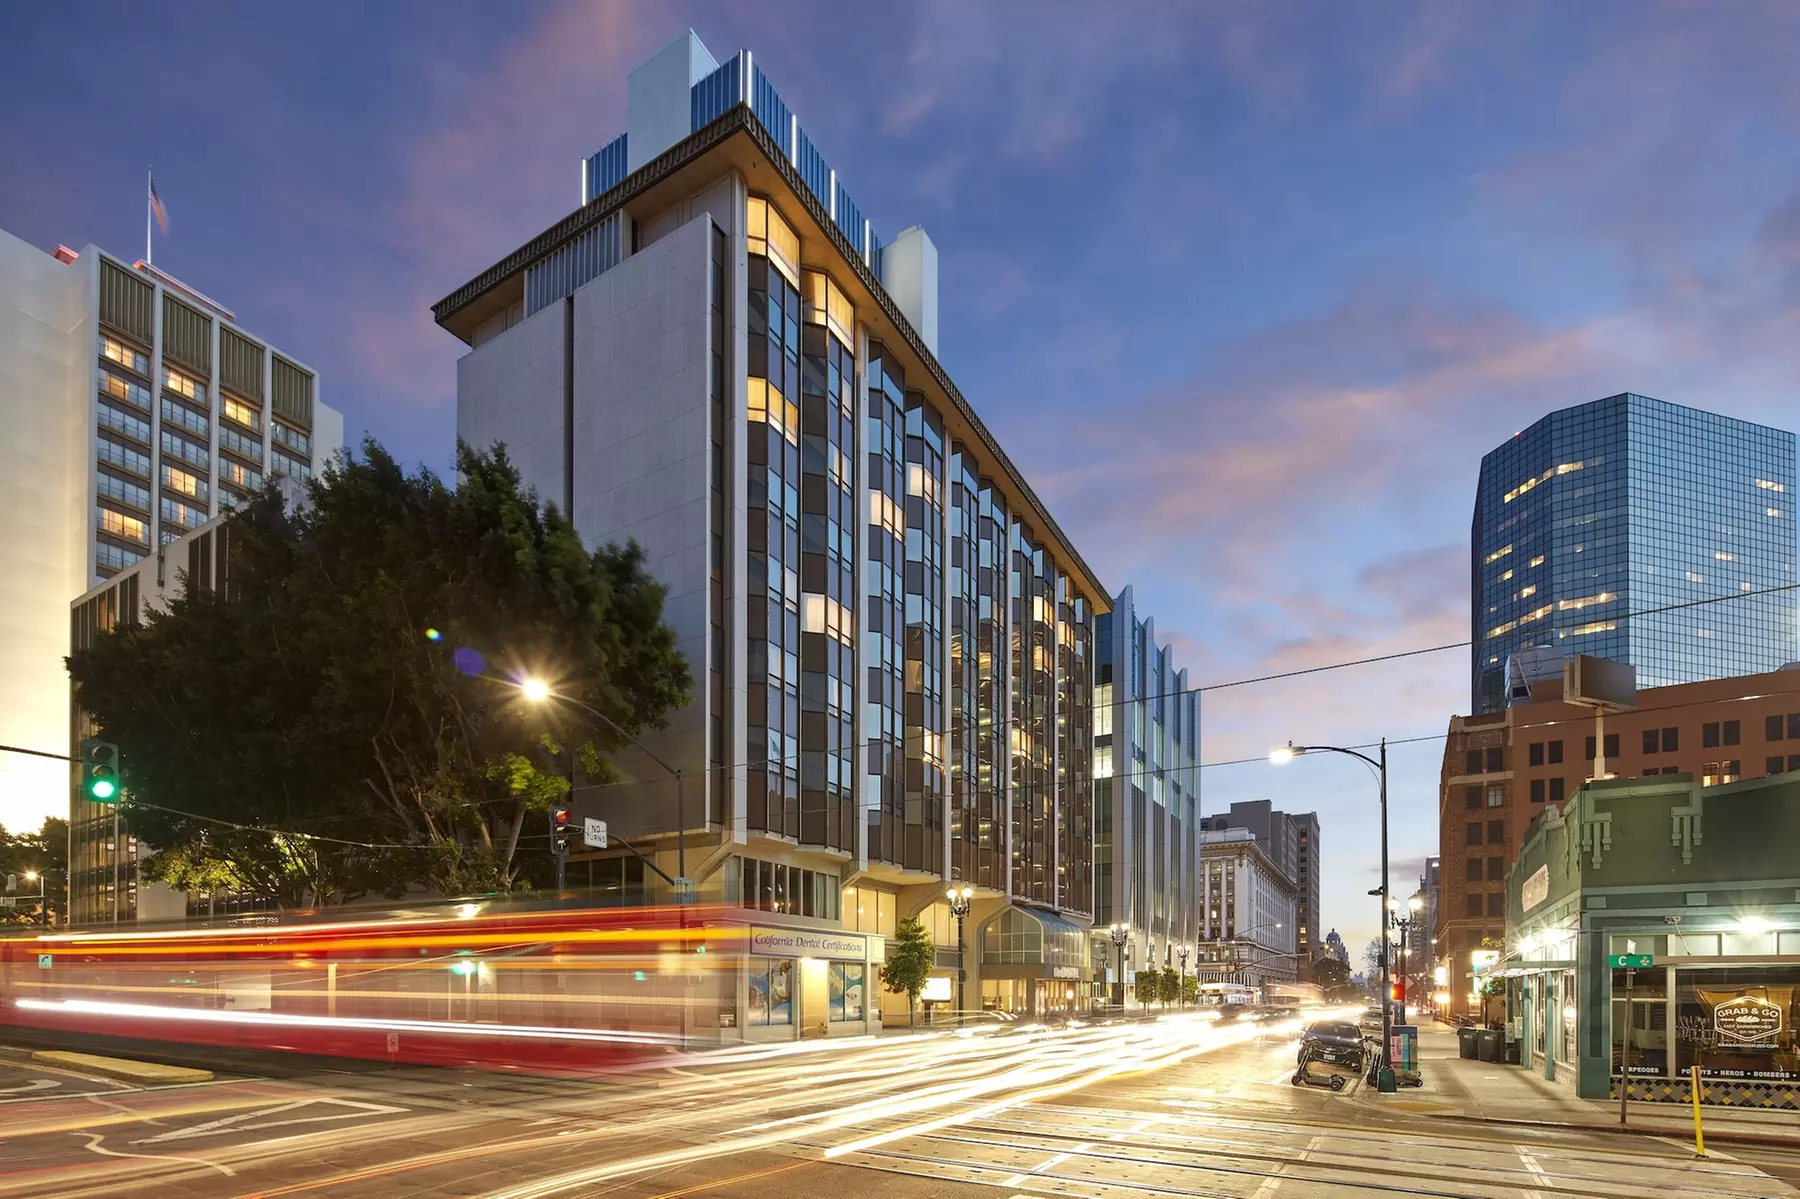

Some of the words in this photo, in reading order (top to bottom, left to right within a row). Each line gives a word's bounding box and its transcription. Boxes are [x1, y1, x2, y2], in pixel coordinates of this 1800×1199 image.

[591, 825, 600, 833] NO
[587, 833, 605, 843] TURNS
[755, 933, 793, 948] California
[796, 936, 820, 949] Dental
[822, 939, 863, 953] Certifications
[1618, 955, 1627, 966] C
[1717, 1007, 1749, 1017] GRAB
[1751, 1007, 1759, 1015] &
[1761, 1009, 1779, 1018] GO
